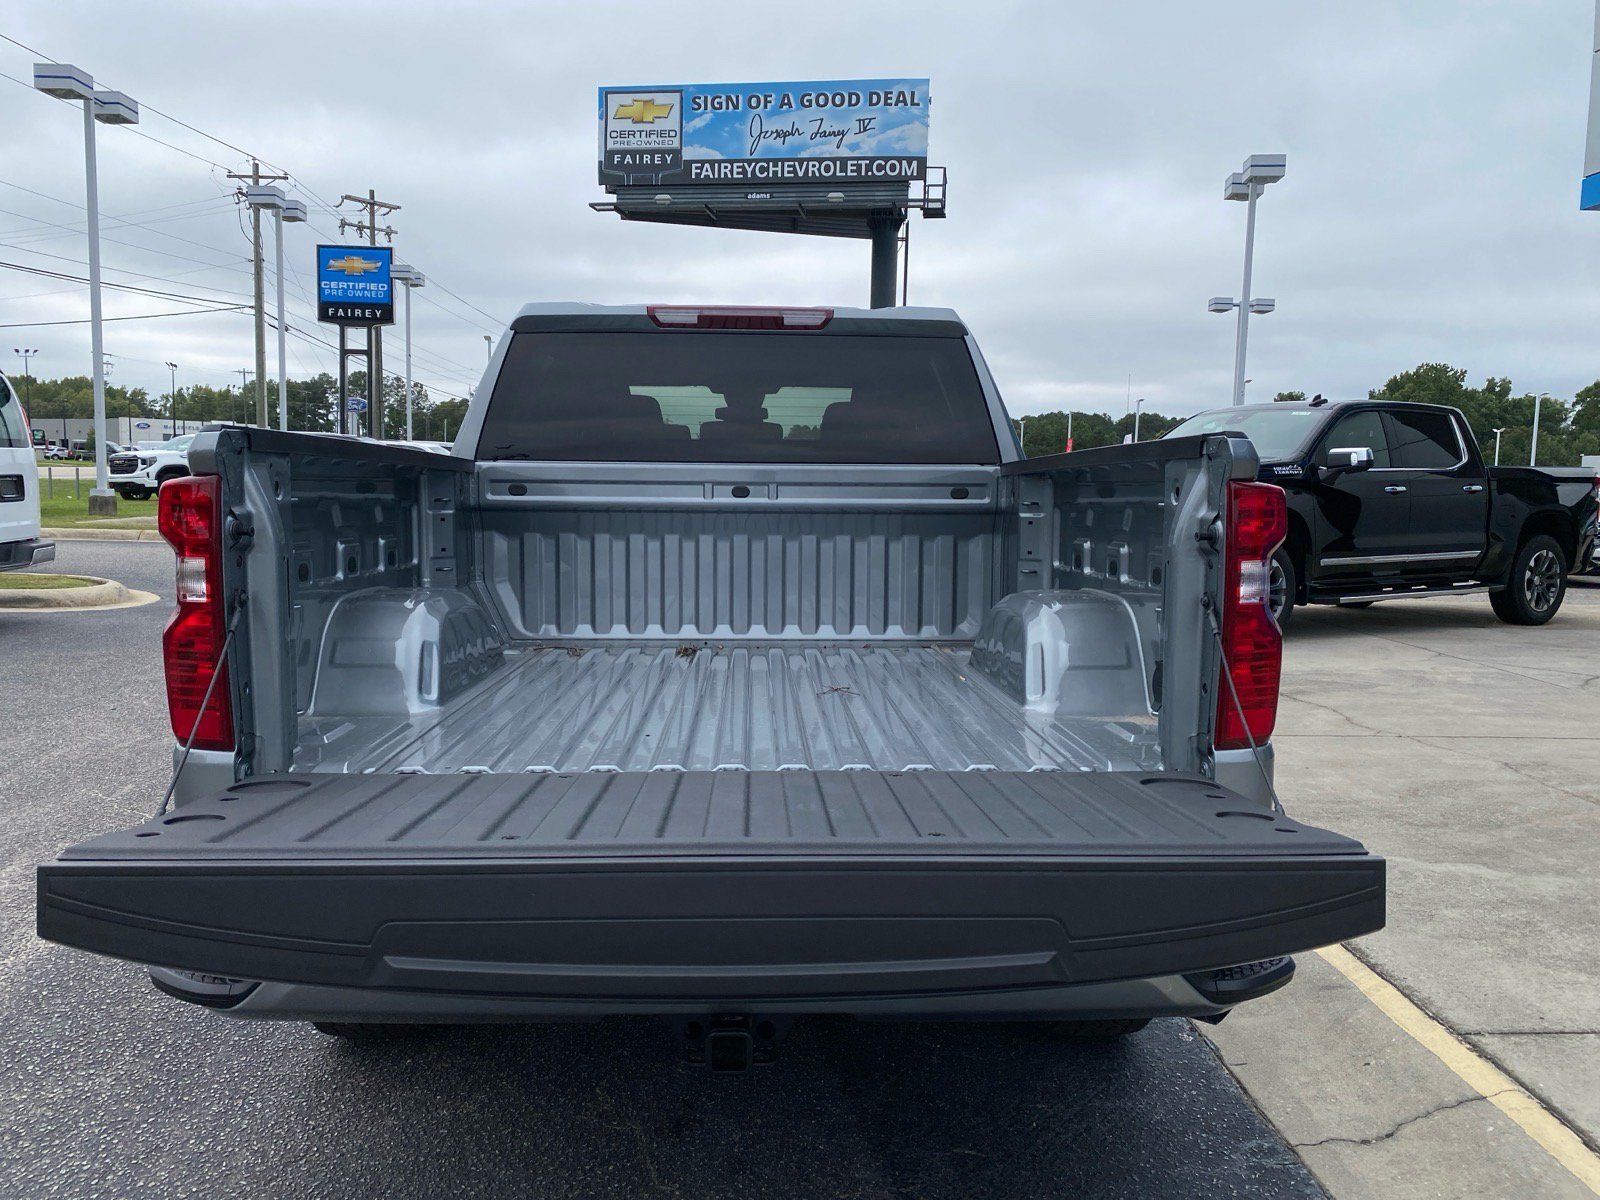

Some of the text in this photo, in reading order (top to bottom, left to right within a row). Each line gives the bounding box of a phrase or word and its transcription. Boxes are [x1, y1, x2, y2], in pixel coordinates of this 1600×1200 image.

[691, 90, 921, 112] SIGN OF A GOOD DEAL
[609, 129, 678, 139] CERTIFIED
[749, 113, 805, 156] Joseph
[853, 116, 877, 135] IV
[612, 139, 674, 147] PRE-OWNED
[613, 153, 673, 165] FAIREY
[691, 159, 918, 179] FAIREYCHEVROLET.COM
[747, 192, 771, 200] adams
[321, 281, 388, 291] CERTIFIED
[324, 289, 384, 298] PRE-OWNED
[328, 308, 382, 318] FAIREY
